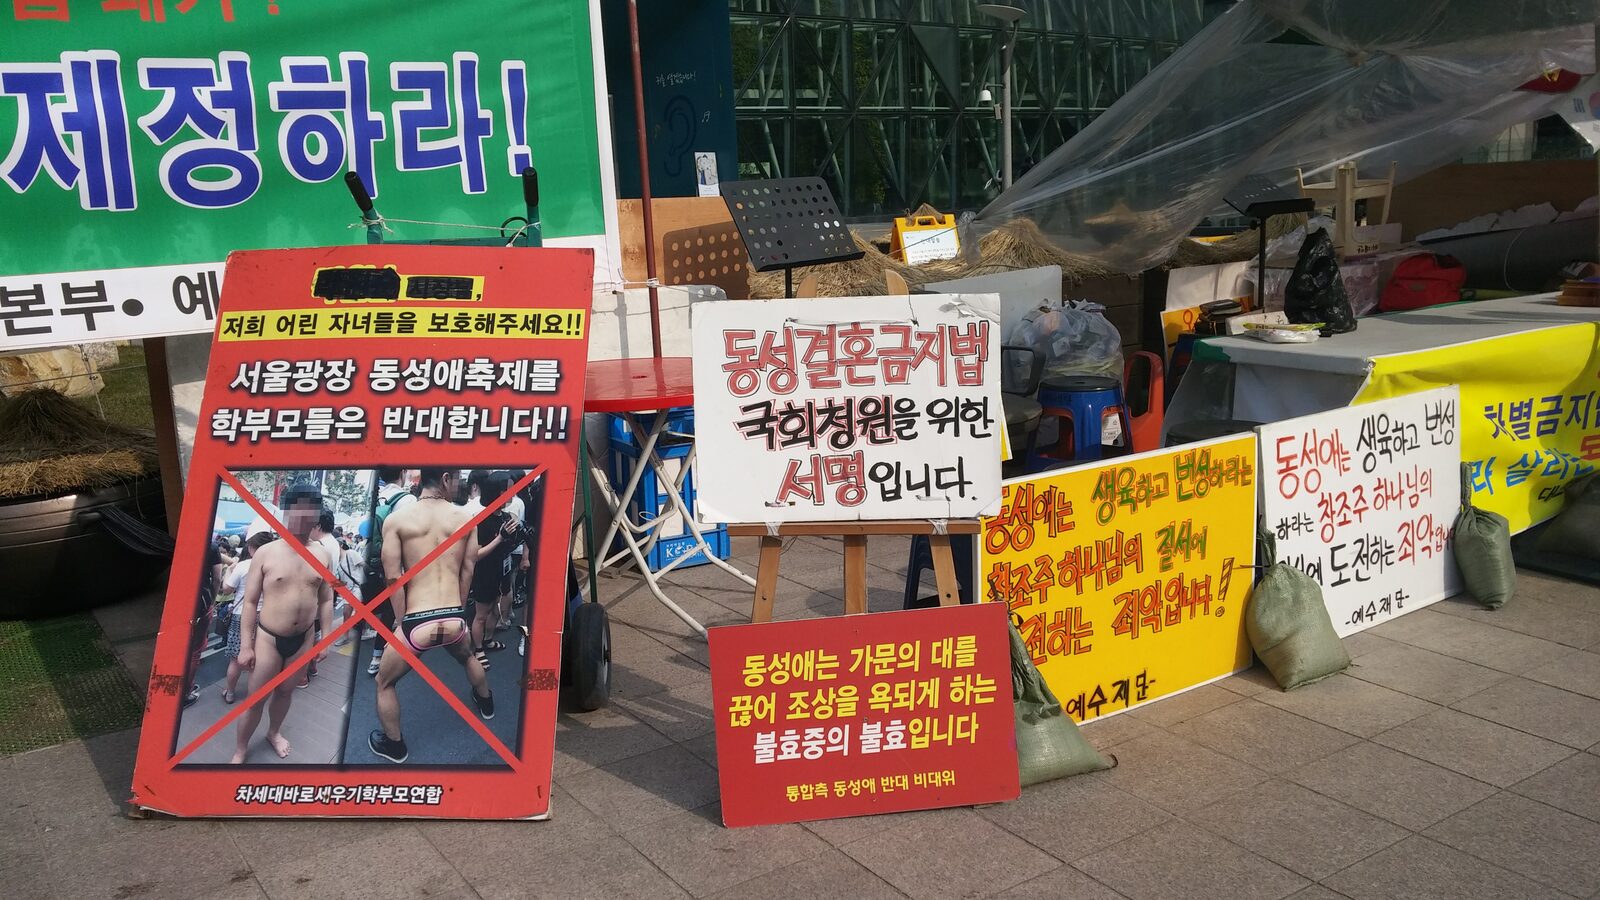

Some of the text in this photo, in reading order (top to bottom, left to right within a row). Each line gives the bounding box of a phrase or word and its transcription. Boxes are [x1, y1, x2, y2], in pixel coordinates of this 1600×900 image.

[2, 50, 533, 211] 제정하라!
[223, 311, 582, 337] 저희 어린 자녀들을 보호해주세요!!
[230, 358, 561, 394] 서울광장 동성애축제를
[721, 320, 990, 397] 동성결혼금지법
[211, 405, 568, 441] 학부모들은 반대합니다!!
[734, 395, 995, 451] 국회청원을 위한
[1276, 399, 1455, 500] 동성애는 생육하고 번성
[777, 451, 978, 507] 서명입니다.
[1091, 466, 1169, 526] 생육하고
[1173, 448, 1253, 503] 번성하라는
[1276, 463, 1432, 544] 하라는 창조주 하나님의
[1057, 530, 1143, 595] 하나님의
[1155, 518, 1208, 573] 질서에
[1330, 533, 1395, 588] 도전하는
[742, 635, 978, 687] 동성애는 가문의 대를
[1020, 606, 1094, 667] 전하는
[728, 673, 997, 728] 끊어 조상을 욕되게 하는
[753, 712, 979, 764] 불효중의 불효입니다
[235, 784, 442, 805] 차세대바로세우기학부모연합
[785, 770, 956, 803] 통합측 동성애 반대 비대위
